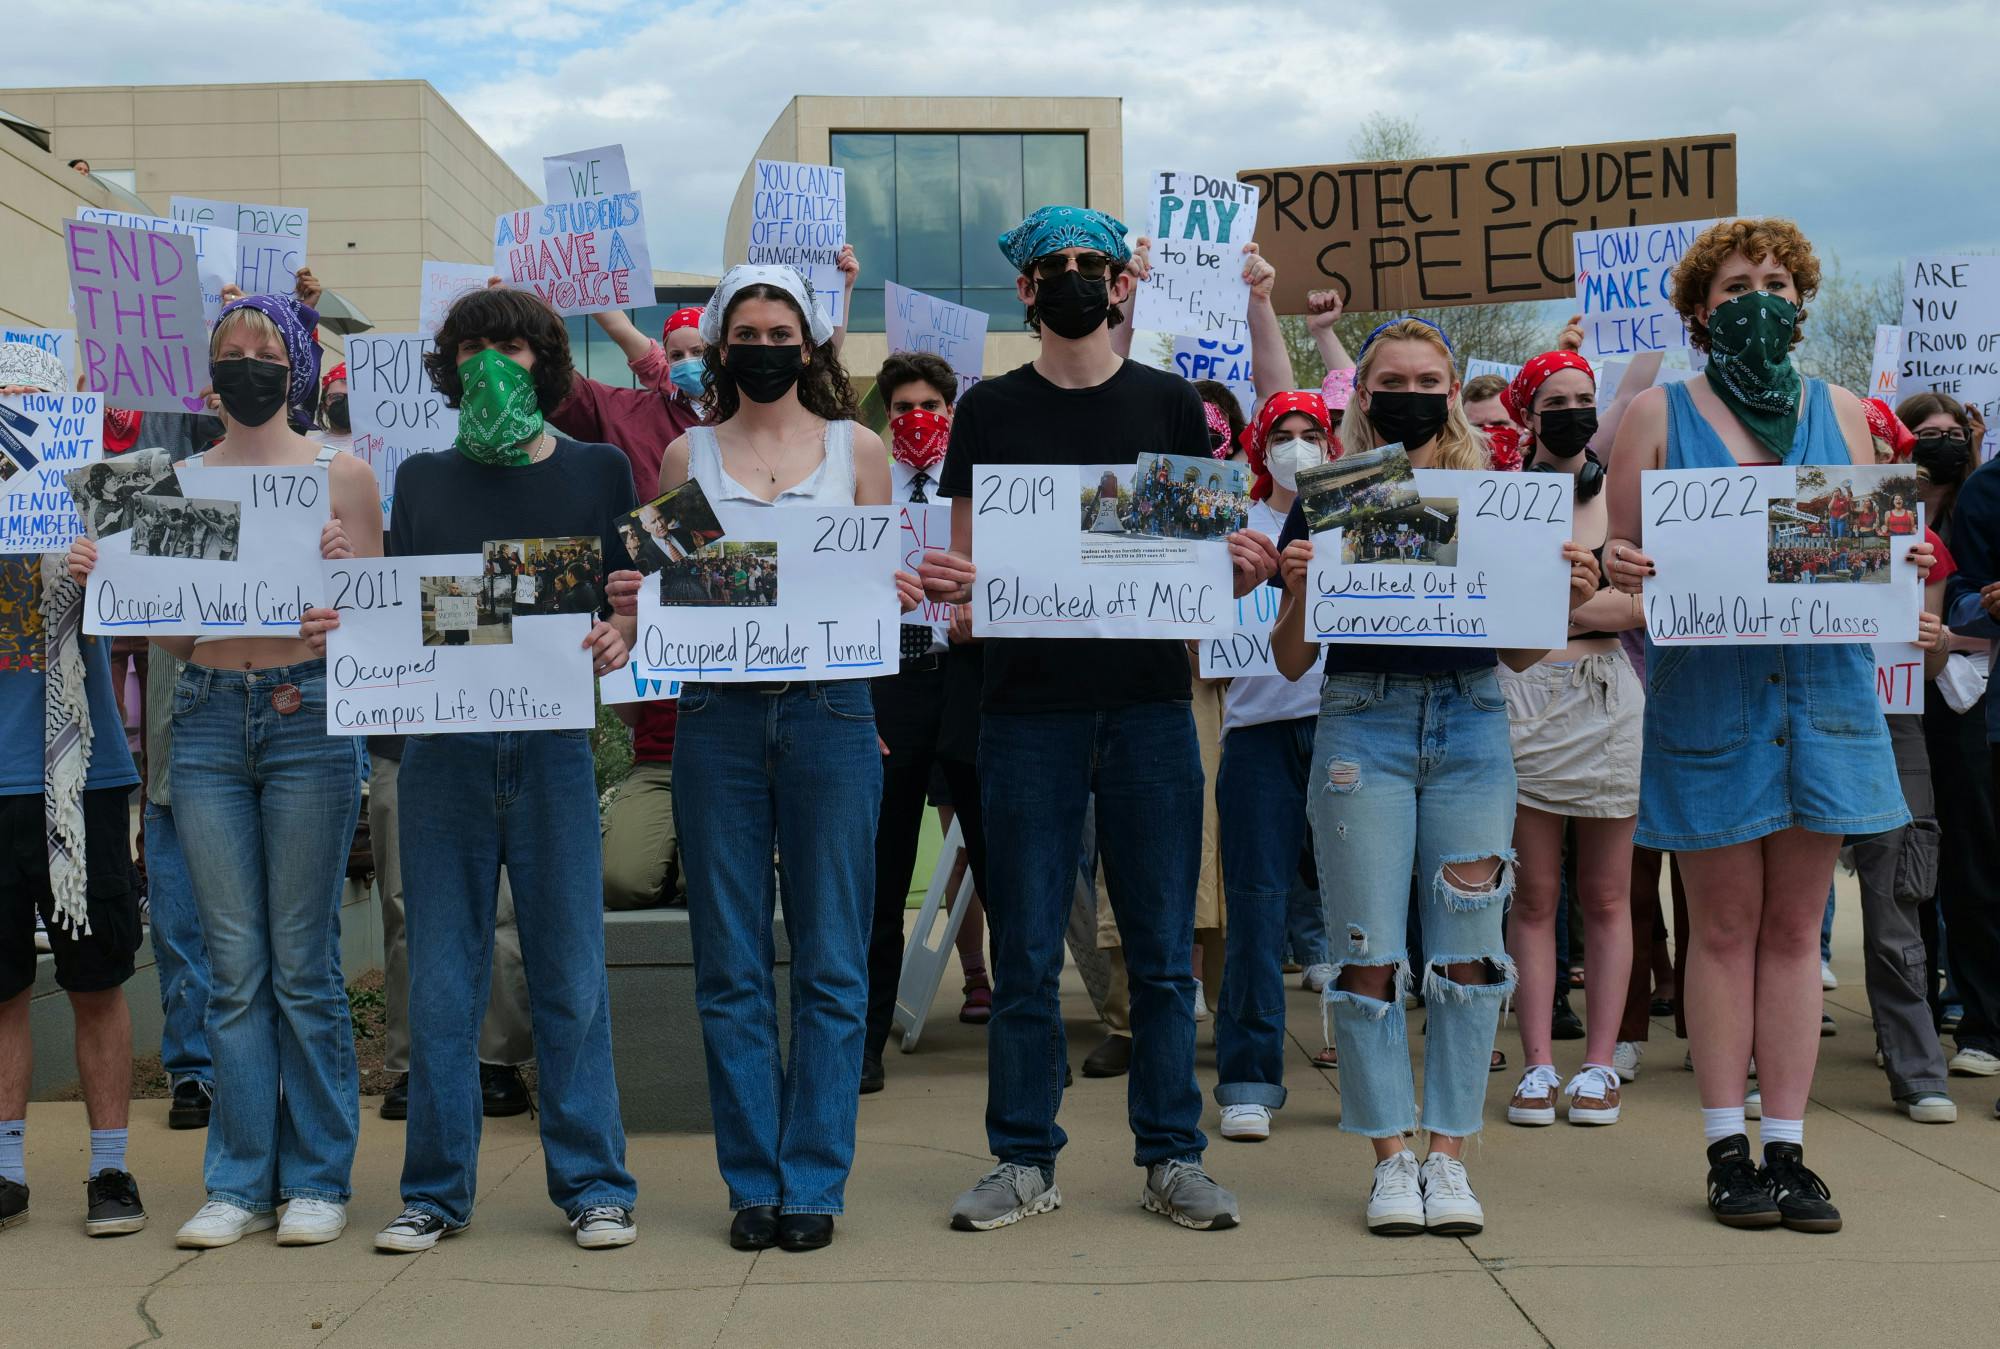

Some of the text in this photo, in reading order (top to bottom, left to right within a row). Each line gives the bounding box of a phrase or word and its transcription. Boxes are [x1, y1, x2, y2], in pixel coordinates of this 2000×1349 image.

[569, 160, 603, 198] WE
[759, 162, 843, 200] YOU CAN'T
[1160, 172, 1254, 204] I DON'T
[1238, 142, 1732, 232] PROTECT STUDENT
[237, 205, 303, 237] have
[497, 192, 640, 247] AU STUDENTS
[755, 191, 844, 223] CAPITALIZE
[1158, 195, 1240, 243] PAY
[752, 221, 792, 245] OFF
[1577, 226, 1695, 273] HOW CAN
[69, 224, 183, 286] END
[236, 246, 299, 296] HTS
[509, 229, 635, 283] HAVE A
[748, 245, 840, 266] CHANGEMAKIN
[1160, 243, 1220, 269] to be
[1316, 208, 1637, 310] SPEEC
[1914, 261, 1970, 289] ARE
[534, 268, 629, 309] VOICE
[78, 285, 184, 340] THE
[895, 287, 970, 341] WE WILL
[1911, 297, 1958, 323] YOU
[1595, 313, 1667, 355] LIKE
[1908, 330, 1967, 353] PROUD
[1977, 332, 2000, 353] OF
[85, 337, 199, 402] BAN!
[350, 338, 438, 395] PROT
[22, 394, 97, 415] HOW DO
[1927, 379, 1963, 395] THE
[47, 415, 86, 438] YOU
[375, 398, 440, 430] OUR
[41, 439, 94, 462] WANT
[38, 468, 80, 491] YOU
[252, 473, 319, 509] 1970
[978, 474, 1054, 516] 2019
[8, 491, 74, 512] TENUR
[1475, 479, 1567, 524] 2022
[1651, 475, 1764, 527] 2022
[0, 513, 87, 539] EMEMBERE
[813, 515, 890, 553] 2017
[330, 568, 403, 611] 2011
[987, 576, 1099, 623] Blocked
[1106, 580, 1139, 616] off
[1148, 580, 1216, 623] MGC
[1317, 570, 1488, 595] Walked Out of
[97, 580, 187, 629] Occupied
[192, 582, 248, 623] Ward
[1313, 600, 1488, 635] Convocation
[1650, 592, 1880, 640] Walked Out of Classes
[334, 648, 437, 688] Occupied
[644, 619, 883, 680] Occupied Bender Tunnel
[1210, 631, 1272, 669] ADV
[1877, 662, 1921, 706] NT
[335, 686, 562, 733] Campus Life Office
